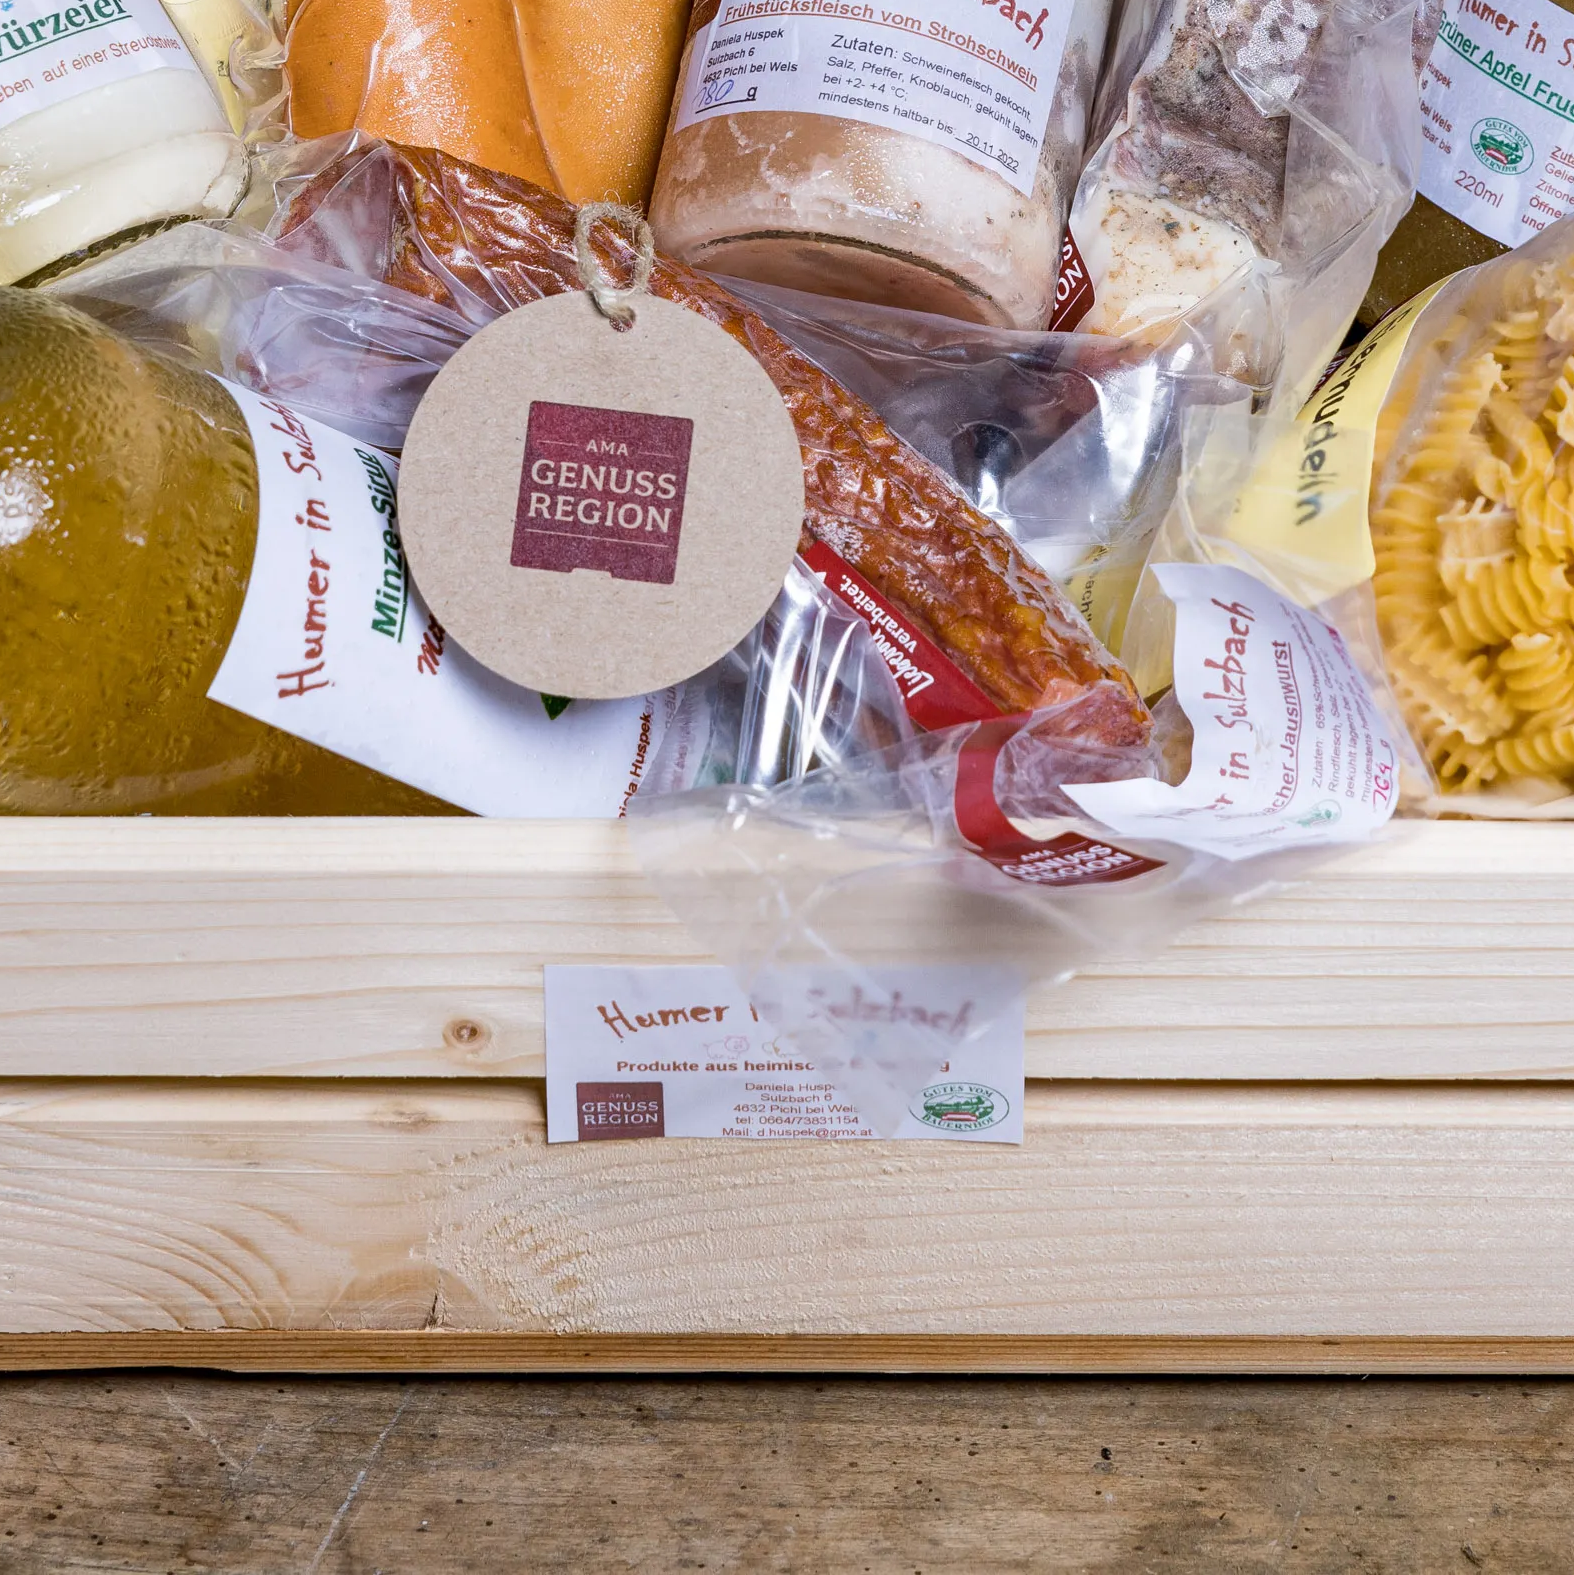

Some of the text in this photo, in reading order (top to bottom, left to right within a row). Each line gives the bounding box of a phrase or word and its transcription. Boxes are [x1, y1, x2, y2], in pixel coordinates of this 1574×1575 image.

[712, 28, 784, 50] Daniela Huspek
[878, 8, 922, 33] vom
[927, 21, 1038, 87] Strohschwein
[1520, 21, 1554, 56] in
[41, 60, 69, 83] auf
[69, 44, 109, 73] einer
[703, 61, 797, 83] 4632 Pichl bei Wels
[707, 46, 755, 67] Sulzbach 6
[1478, 47, 1531, 90] Apfel
[746, 85, 757, 100] g
[822, 72, 842, 87] bei
[844, 76, 866, 90] +2-
[868, 80, 886, 95] +4
[831, 33, 1033, 123] Zutaten: Schweinefleisch gekocht,
[827, 55, 856, 71] Salz,
[860, 61, 906, 83] Pfeffer,
[974, 101, 1011, 129] gekühlt
[1011, 121, 1038, 148] lagern
[1418, 100, 1452, 132] bei Wels
[818, 89, 1019, 171] mindestens haltbar bis: 20.11.2022
[1438, 138, 1452, 154] bis
[1453, 169, 1505, 207] 220ml
[1520, 212, 1545, 232] und
[585, 439, 629, 456] AMA
[530, 458, 677, 499] GENUSS
[528, 491, 672, 533] REGION
[259, 401, 330, 697] Humer in Sulzb
[354, 448, 400, 638] Minze-Sirup
[839, 574, 917, 653] verarbeitet.
[1204, 598, 1255, 730] Sulzbach
[1272, 641, 1297, 757] Jausnwurst
[630, 712, 651, 777] Huspek
[1219, 749, 1253, 780] in
[1311, 738, 1324, 786] Zutaten:
[1001, 845, 1111, 873] GENUSS
[597, 1001, 728, 1038] Humer
[616, 1061, 814, 1071] Produkte aus heimisc
[745, 1082, 835, 1092] Daniela Husp
[760, 1093, 832, 1103] Sulzbach 6
[582, 1101, 658, 1112] GENUSS
[584, 1113, 657, 1125] REGION
[733, 1104, 765, 1112] 4632
[770, 1104, 801, 1113] Pichl
[806, 1105, 824, 1113] bei
[736, 1116, 858, 1124] tel: 0664/73831154
[722, 1128, 872, 1137] Mail: d.huspek@gmx.at
